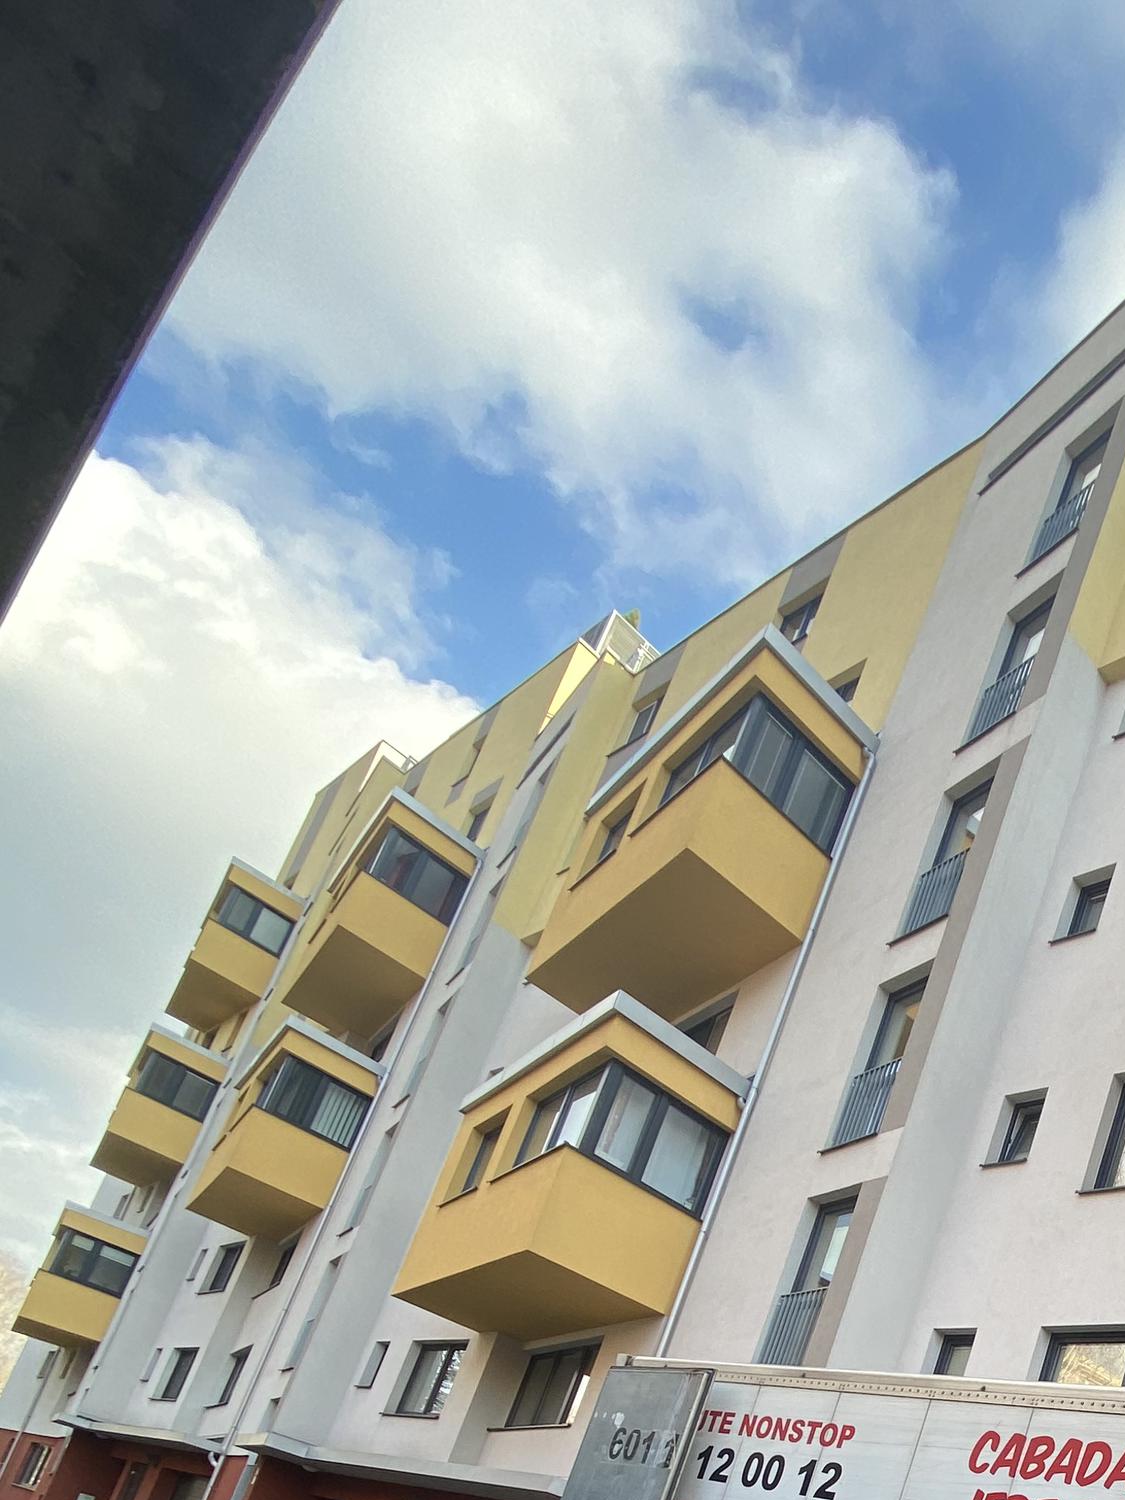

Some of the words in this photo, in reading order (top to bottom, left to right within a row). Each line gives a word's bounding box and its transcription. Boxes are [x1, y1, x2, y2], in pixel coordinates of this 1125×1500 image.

[738, 1414, 855, 1448] NONSTOP
[697, 1446, 735, 1483] 12
[741, 1452, 785, 1491] 00
[798, 1459, 842, 1500] 12
